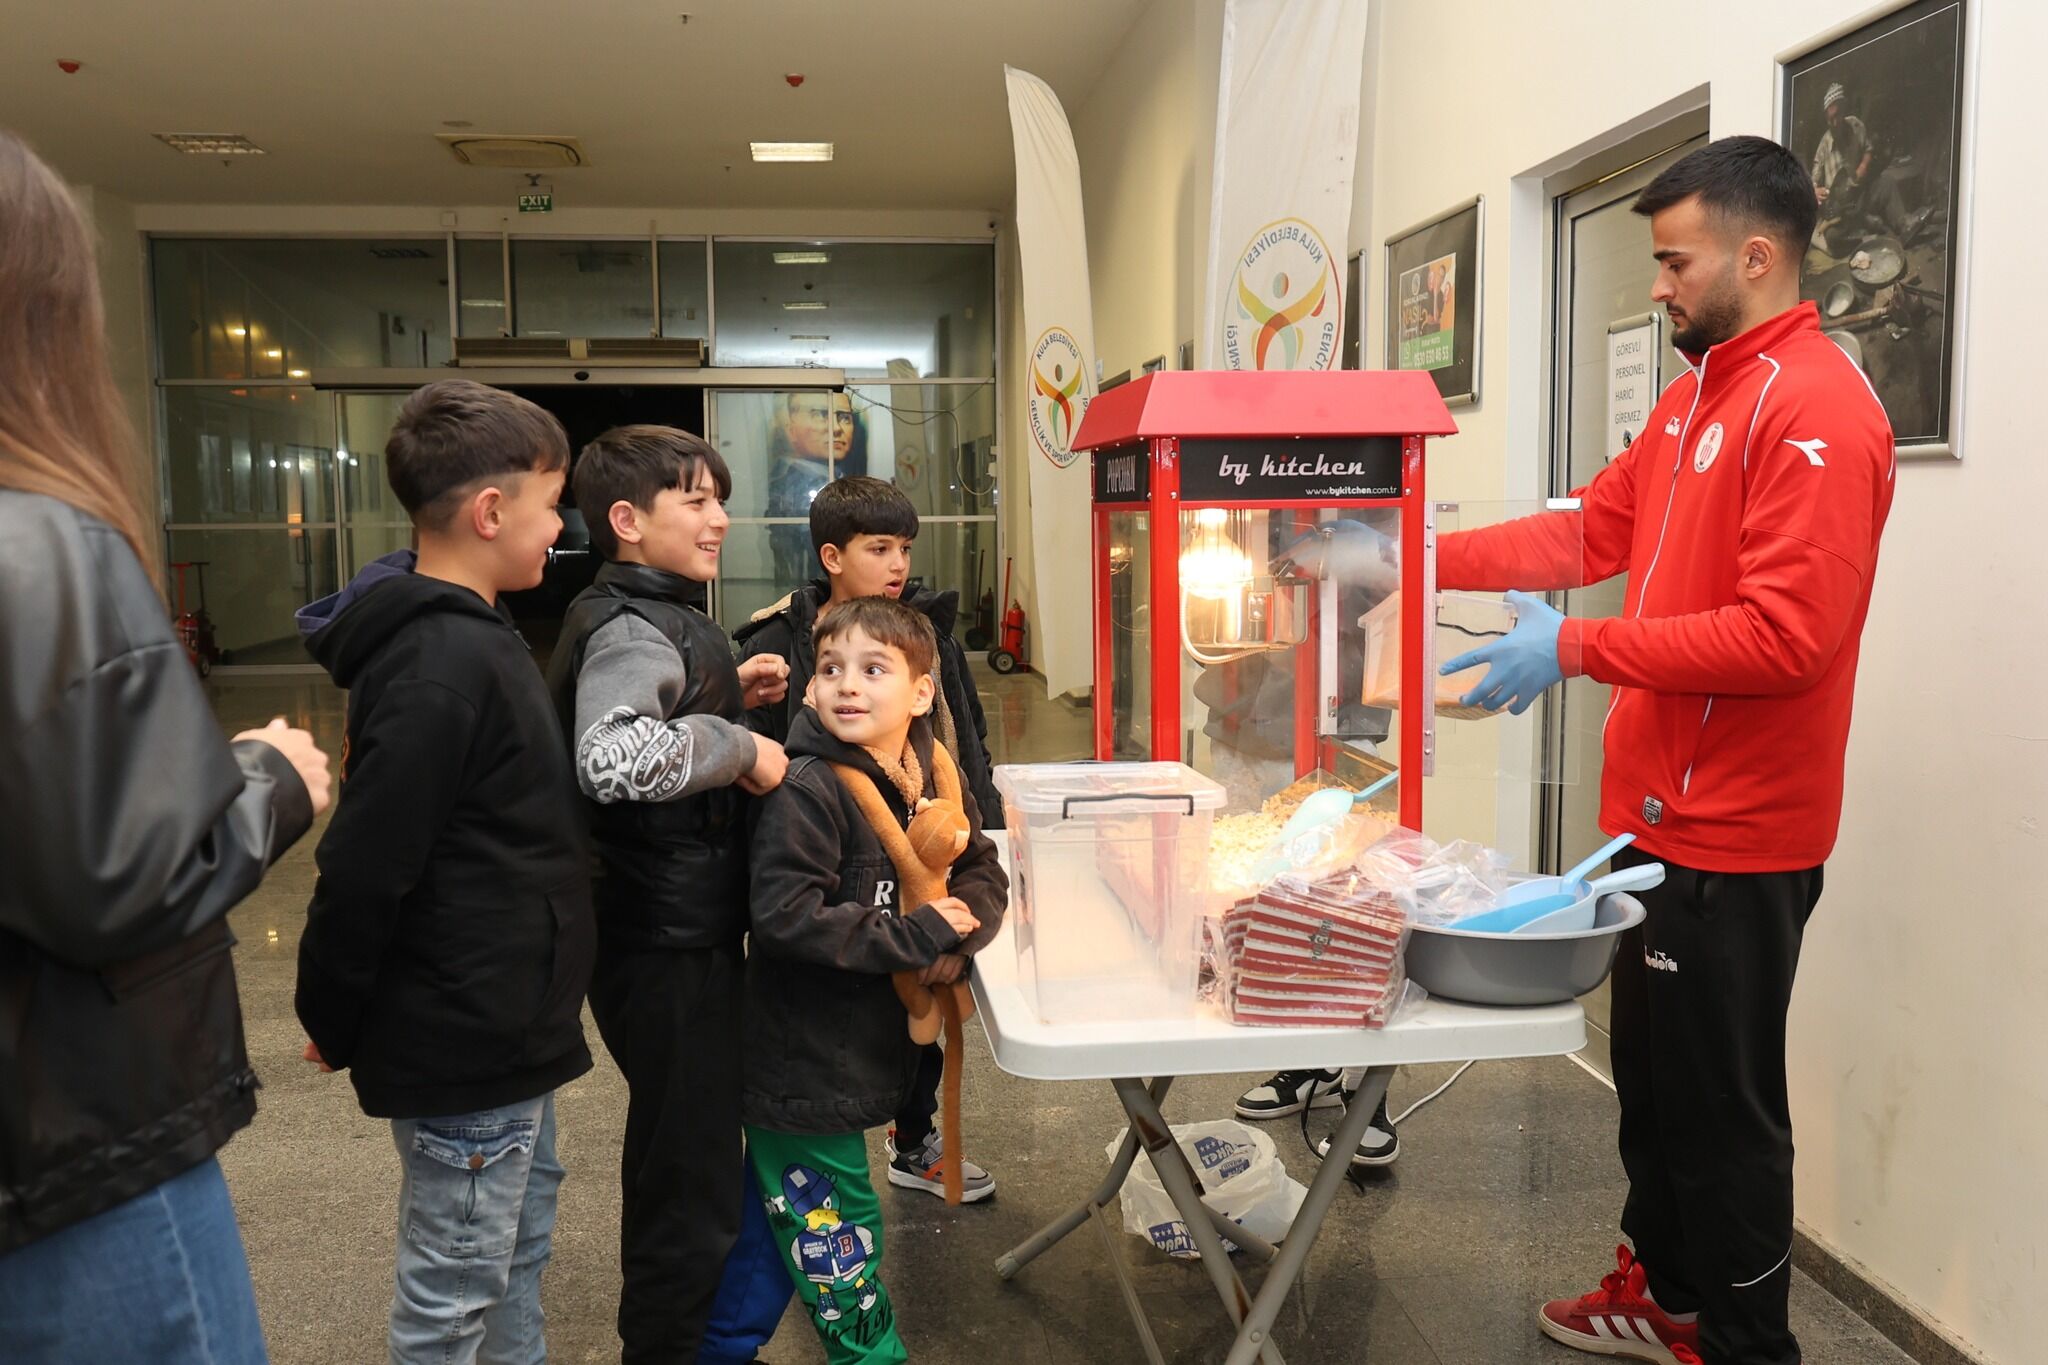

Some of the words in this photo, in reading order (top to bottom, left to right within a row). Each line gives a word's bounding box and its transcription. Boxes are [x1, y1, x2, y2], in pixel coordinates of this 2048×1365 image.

[520, 195, 549, 206] EXIT
[1036, 339, 1050, 360] KULA
[1615, 363, 1646, 379] PERSONEL
[1031, 399, 1046, 443] GENÇLİK
[1044, 440, 1053, 452] VE
[1106, 455, 1136, 494] POPCORN
[1218, 455, 1251, 486] by
[1260, 454, 1365, 477] kitchen
[1305, 486, 1397, 497] www.bykitchen.com.tr
[1311, 919, 1333, 962] POPCORN
